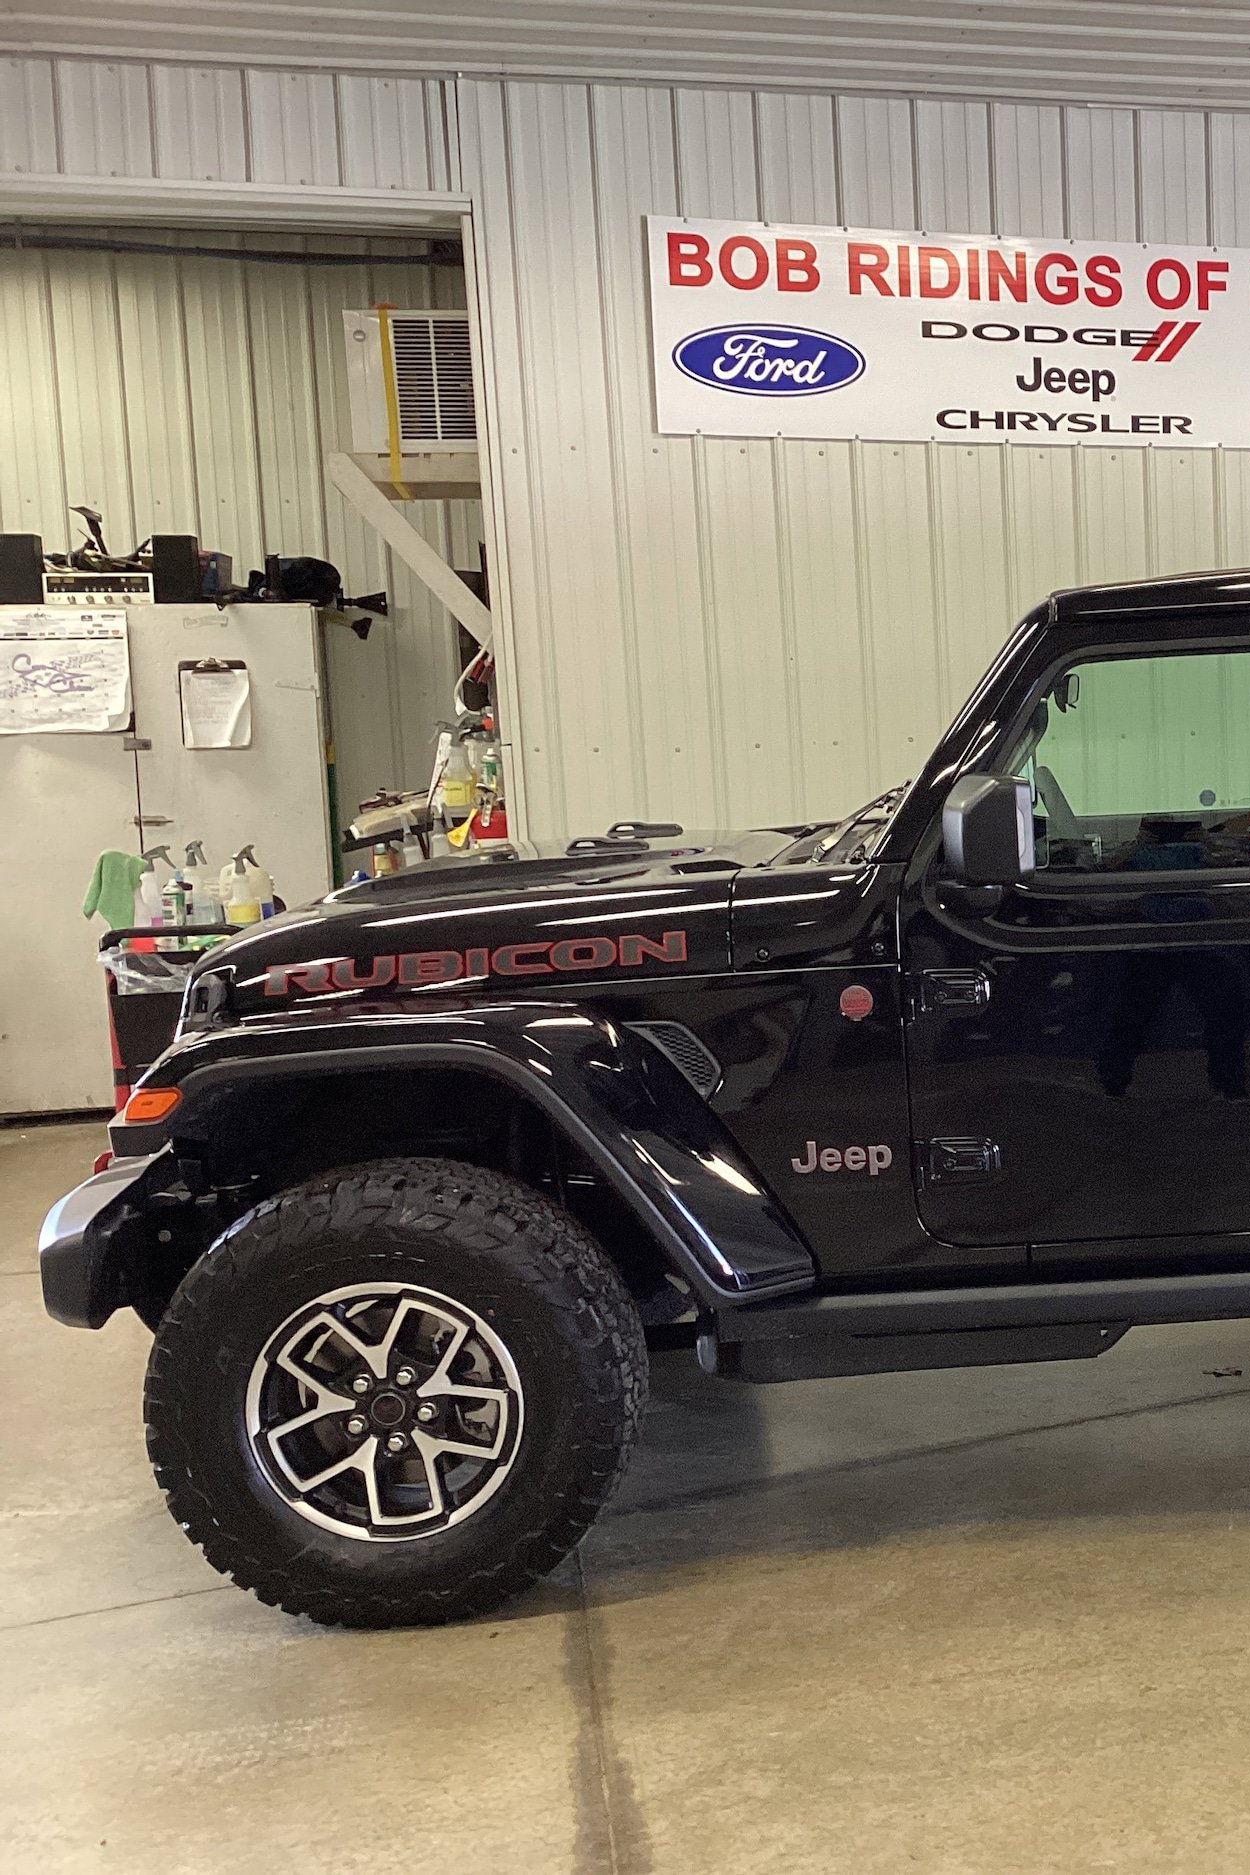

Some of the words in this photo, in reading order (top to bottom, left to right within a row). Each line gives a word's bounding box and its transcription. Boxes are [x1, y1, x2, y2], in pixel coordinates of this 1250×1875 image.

[667, 232, 820, 293] BOB
[848, 242, 1123, 307] RIDINGS
[1146, 258, 1229, 311] OF
[921, 320, 1161, 348] DODGE
[713, 334, 827, 385] Ford
[1016, 357, 1116, 402] Jeep
[936, 409, 1193, 434] CHRYSLER
[264, 931, 687, 996] RUBICON
[791, 1141, 893, 1176] Jeep
